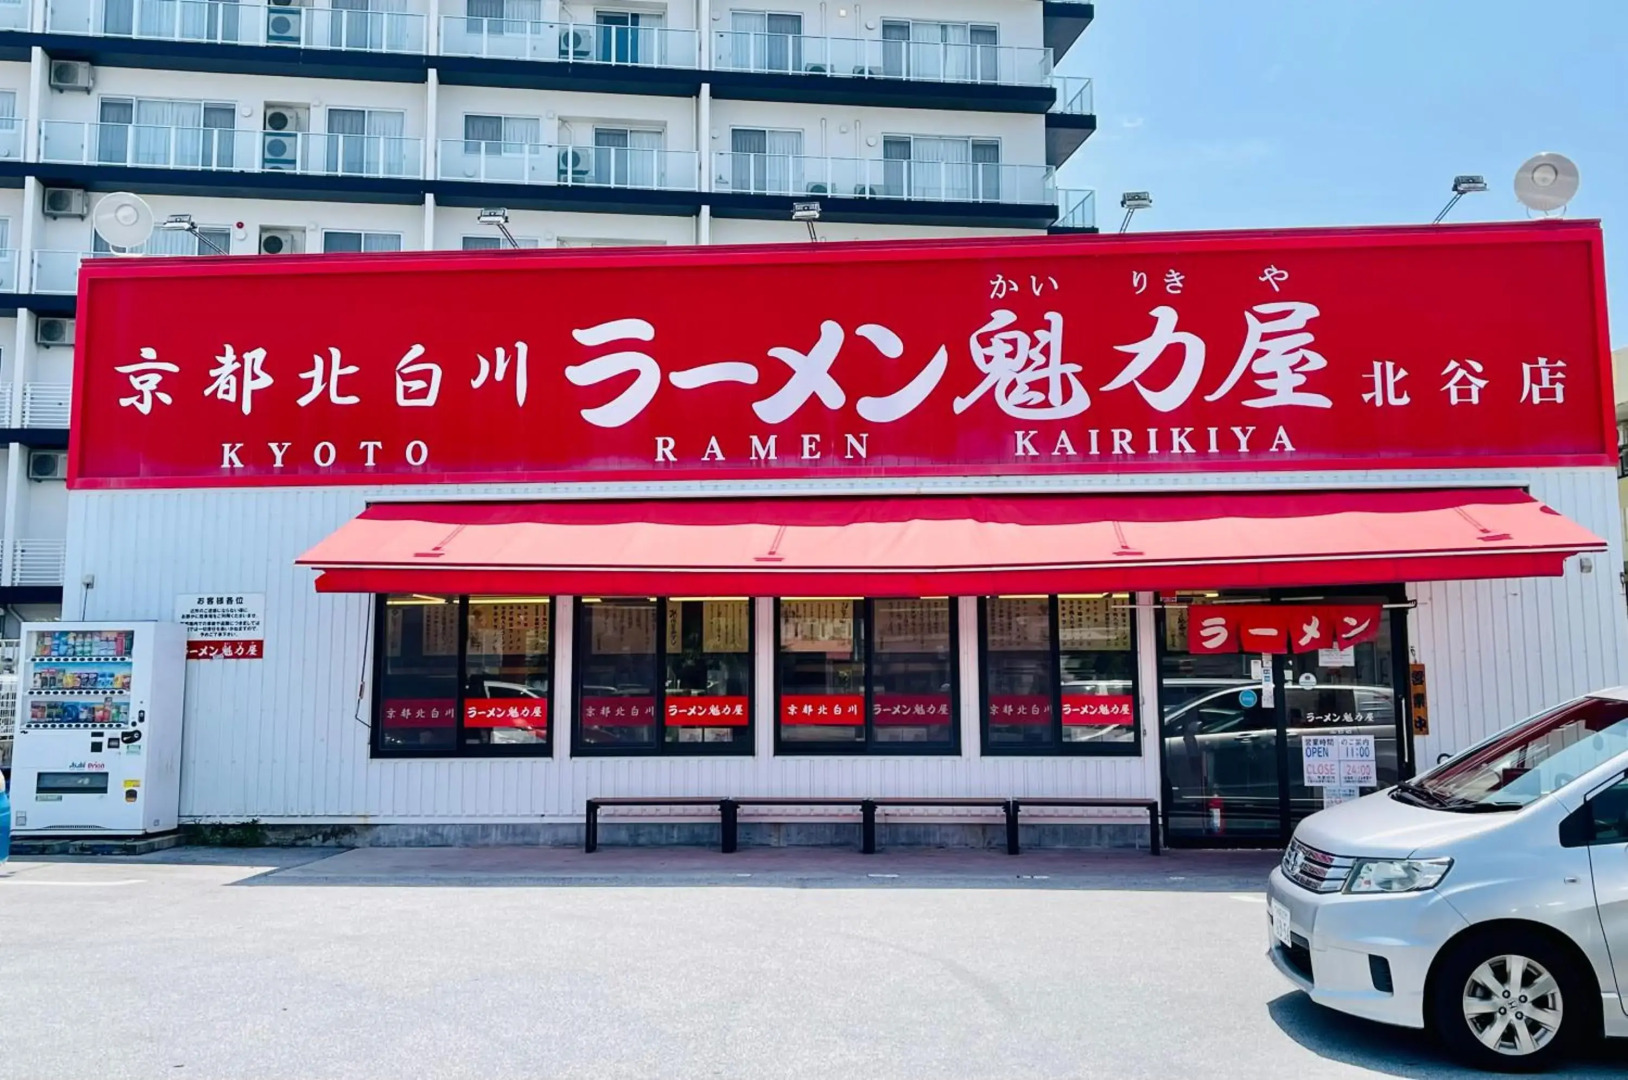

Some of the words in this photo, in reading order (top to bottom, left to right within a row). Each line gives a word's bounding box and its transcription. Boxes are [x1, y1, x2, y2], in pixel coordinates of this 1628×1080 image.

[990, 274, 1059, 299] かい
[1132, 269, 1185, 295] りき
[1258, 264, 1289, 292] や
[114, 341, 528, 416] 京都北白川
[564, 301, 1333, 429] ラーメン魁力屋
[1361, 356, 1567, 407] 北谷店
[221, 440, 428, 469] KYOTO
[655, 433, 869, 463] RAMEN
[1015, 426, 1297, 457] KAIRIKIYA
[1200, 615, 1371, 649] ラーメン
[186, 645, 258, 657] ーメン魁力屋
[467, 706, 543, 718] ラーメン魁力屋
[668, 704, 744, 716] ラーメン魁力屋
[787, 703, 858, 716] 京都北白川
[873, 703, 949, 716] ラーメン魁力屋
[1062, 703, 1131, 715] ラーメン魁力屋
[1305, 746, 1330, 758] OPEN
[1346, 746, 1371, 758] 11:00
[1306, 763, 1336, 775] CLOSE
[1346, 764, 1371, 776] 24:00
